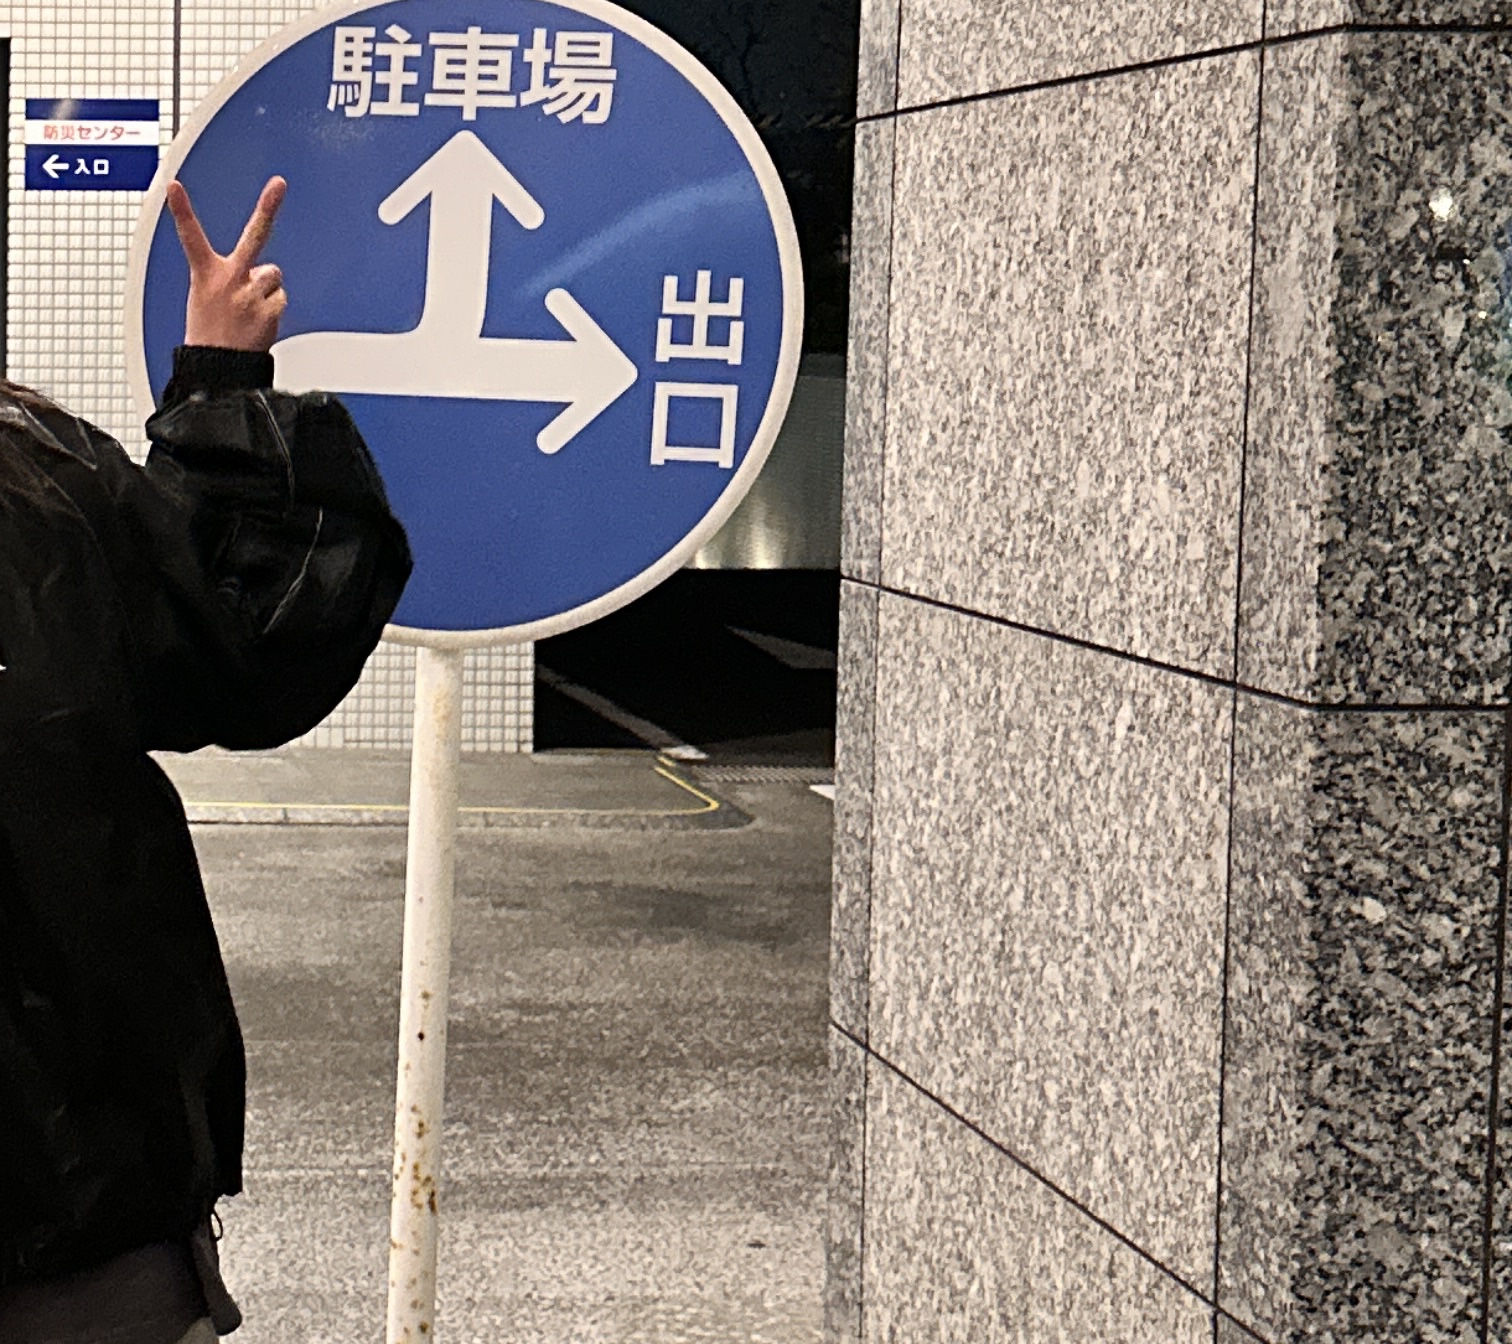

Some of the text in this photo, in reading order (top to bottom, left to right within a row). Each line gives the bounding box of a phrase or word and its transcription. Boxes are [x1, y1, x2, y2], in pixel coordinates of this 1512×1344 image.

[326, 24, 617, 124] 駐車場
[43, 125, 141, 141] 防災センター
[74, 159, 109, 175] 入口
[650, 269, 745, 469] 出口
